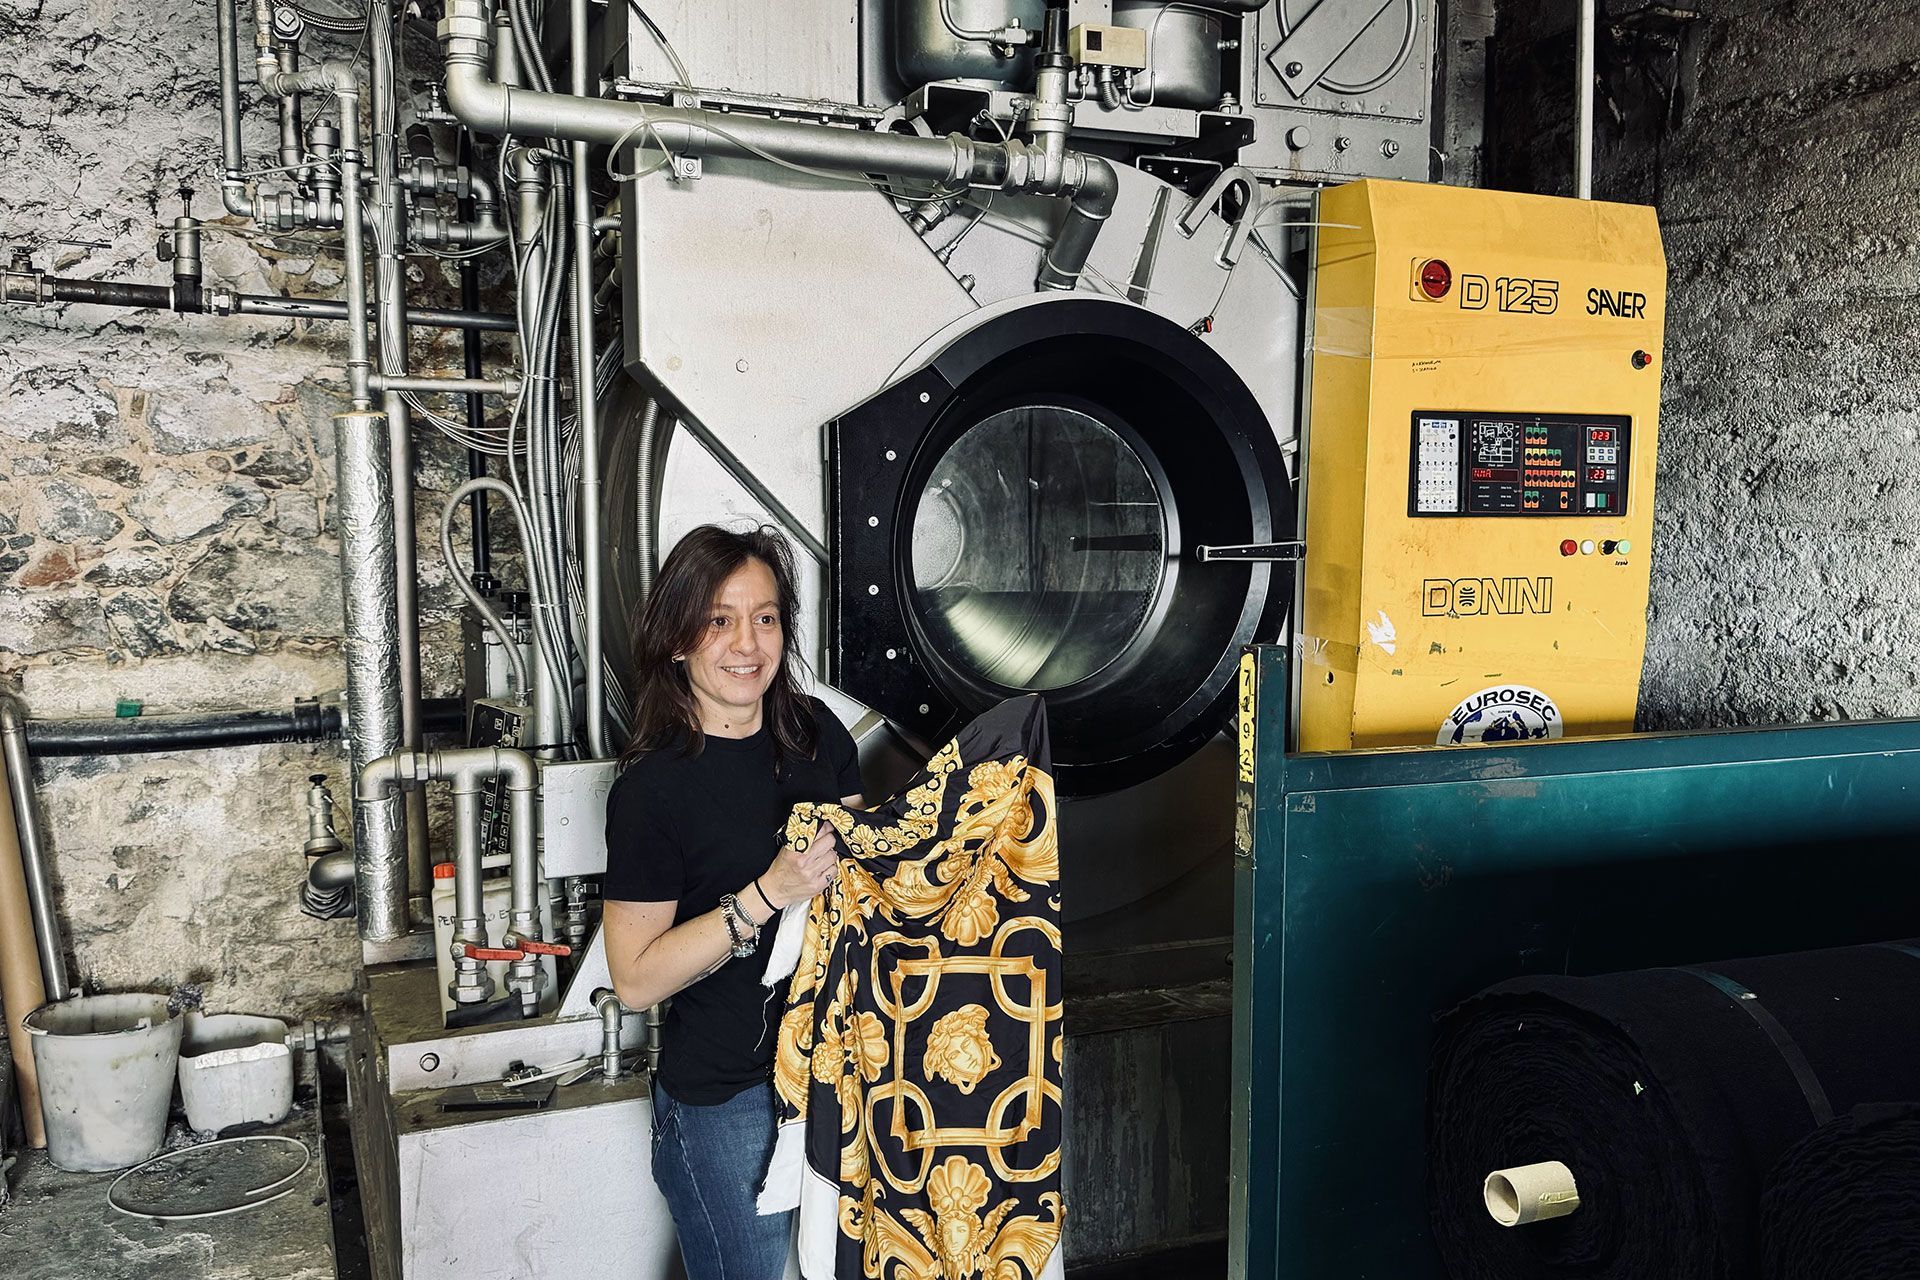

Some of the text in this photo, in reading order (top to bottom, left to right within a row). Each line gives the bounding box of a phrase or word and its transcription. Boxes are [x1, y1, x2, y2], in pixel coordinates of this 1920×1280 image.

[1460, 274, 1559, 314] D 125
[1585, 287, 1647, 319] SAVER
[1591, 431, 1610, 441] 023
[1422, 577, 1553, 617] DONINI
[1452, 689, 1556, 726] EUROSEC
